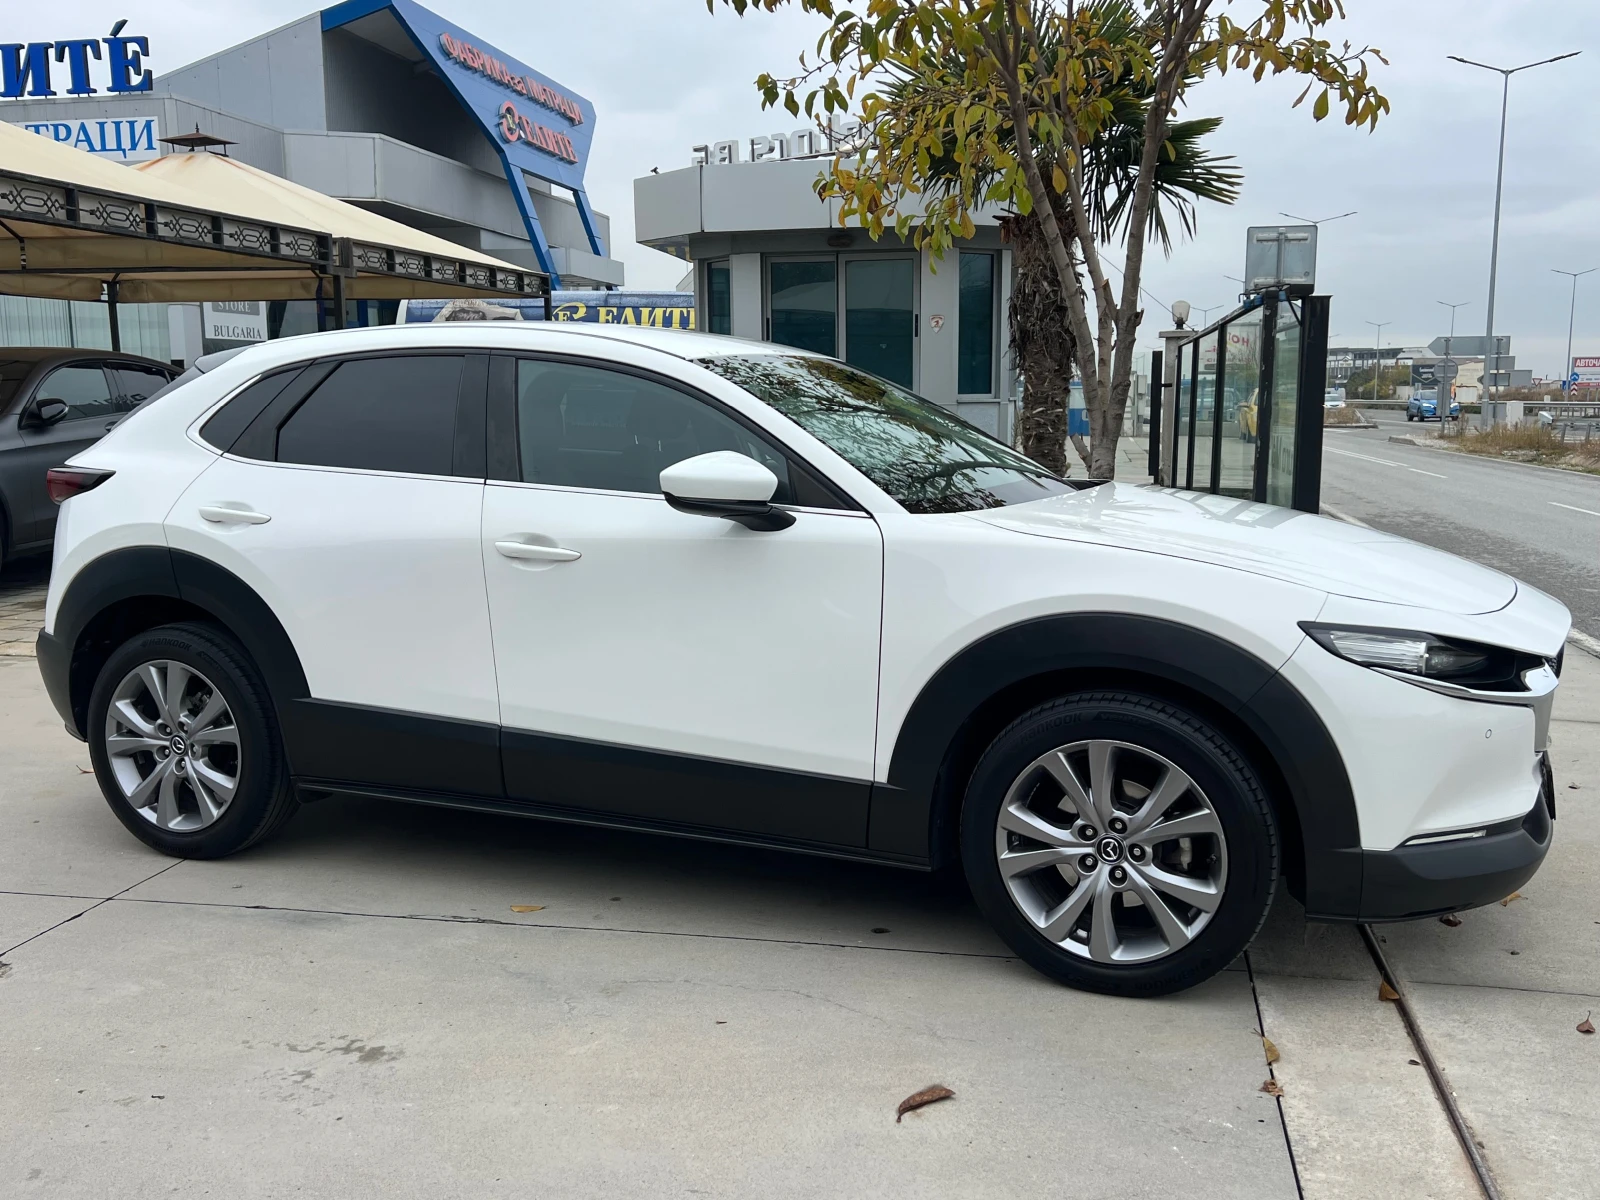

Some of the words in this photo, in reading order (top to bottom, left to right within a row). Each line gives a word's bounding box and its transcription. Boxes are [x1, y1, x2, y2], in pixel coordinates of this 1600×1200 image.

[439, 32, 513, 87] ФАБРИКА
[523, 75, 584, 126] МАТРАЦИ
[218, 301, 251, 313] STORE
[213, 324, 262, 340] BULGARIA
